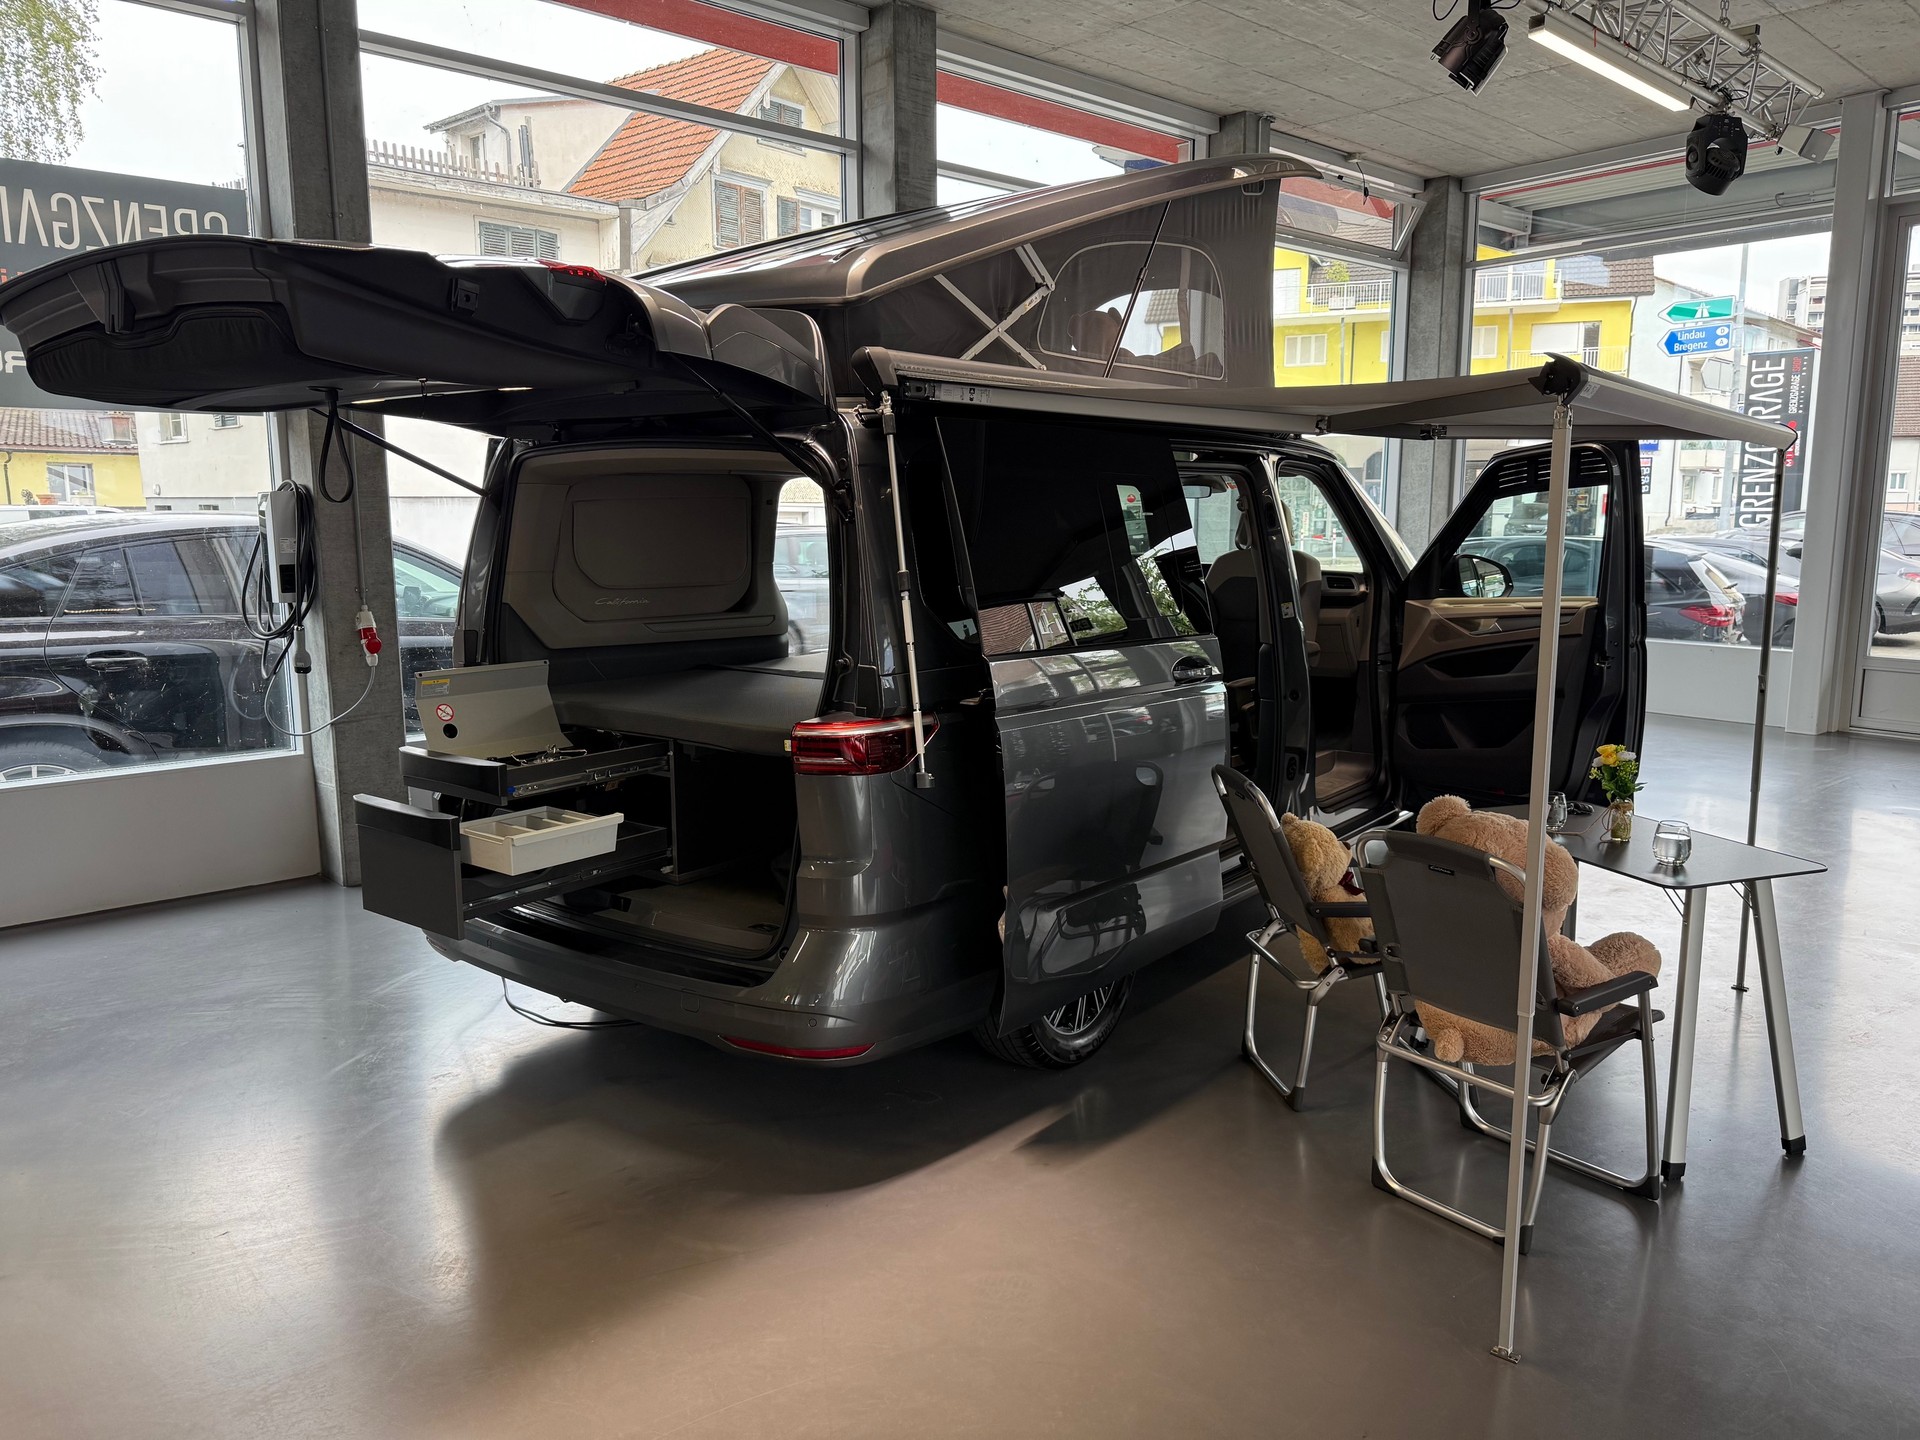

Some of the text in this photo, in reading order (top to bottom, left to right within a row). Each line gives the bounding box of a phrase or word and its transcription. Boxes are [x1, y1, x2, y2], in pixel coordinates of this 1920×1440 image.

[1677, 330, 1706, 341] Lindau
[1673, 341, 1709, 353] Bregenz
[1739, 357, 1786, 529] GRENZRAGE
